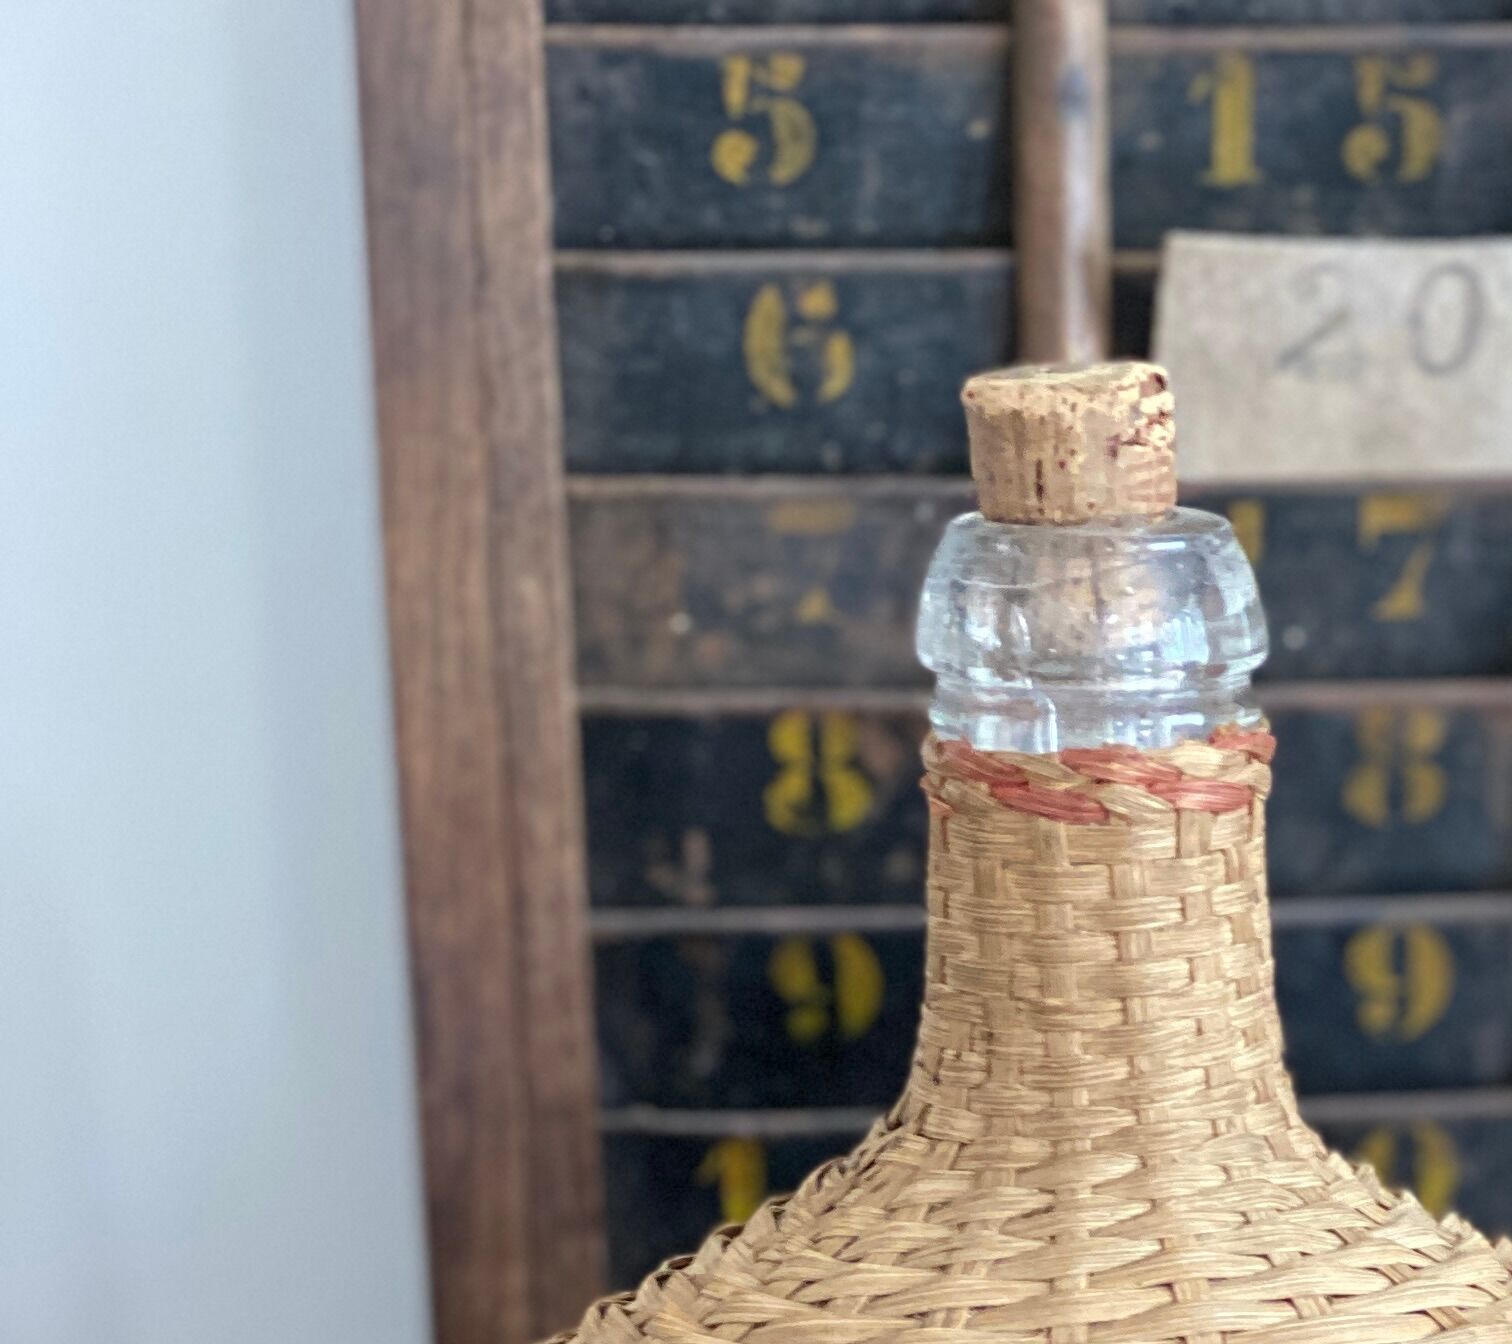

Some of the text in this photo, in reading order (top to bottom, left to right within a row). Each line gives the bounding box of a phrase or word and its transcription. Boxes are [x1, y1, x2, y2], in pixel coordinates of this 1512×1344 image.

[711, 54, 817, 187] 5
[1189, 48, 1444, 187] 15
[742, 280, 855, 407] 6
[1276, 262, 1487, 378] 20
[763, 707, 873, 836] 8
[768, 930, 884, 1046] 9
[1343, 918, 1455, 1046] 9
